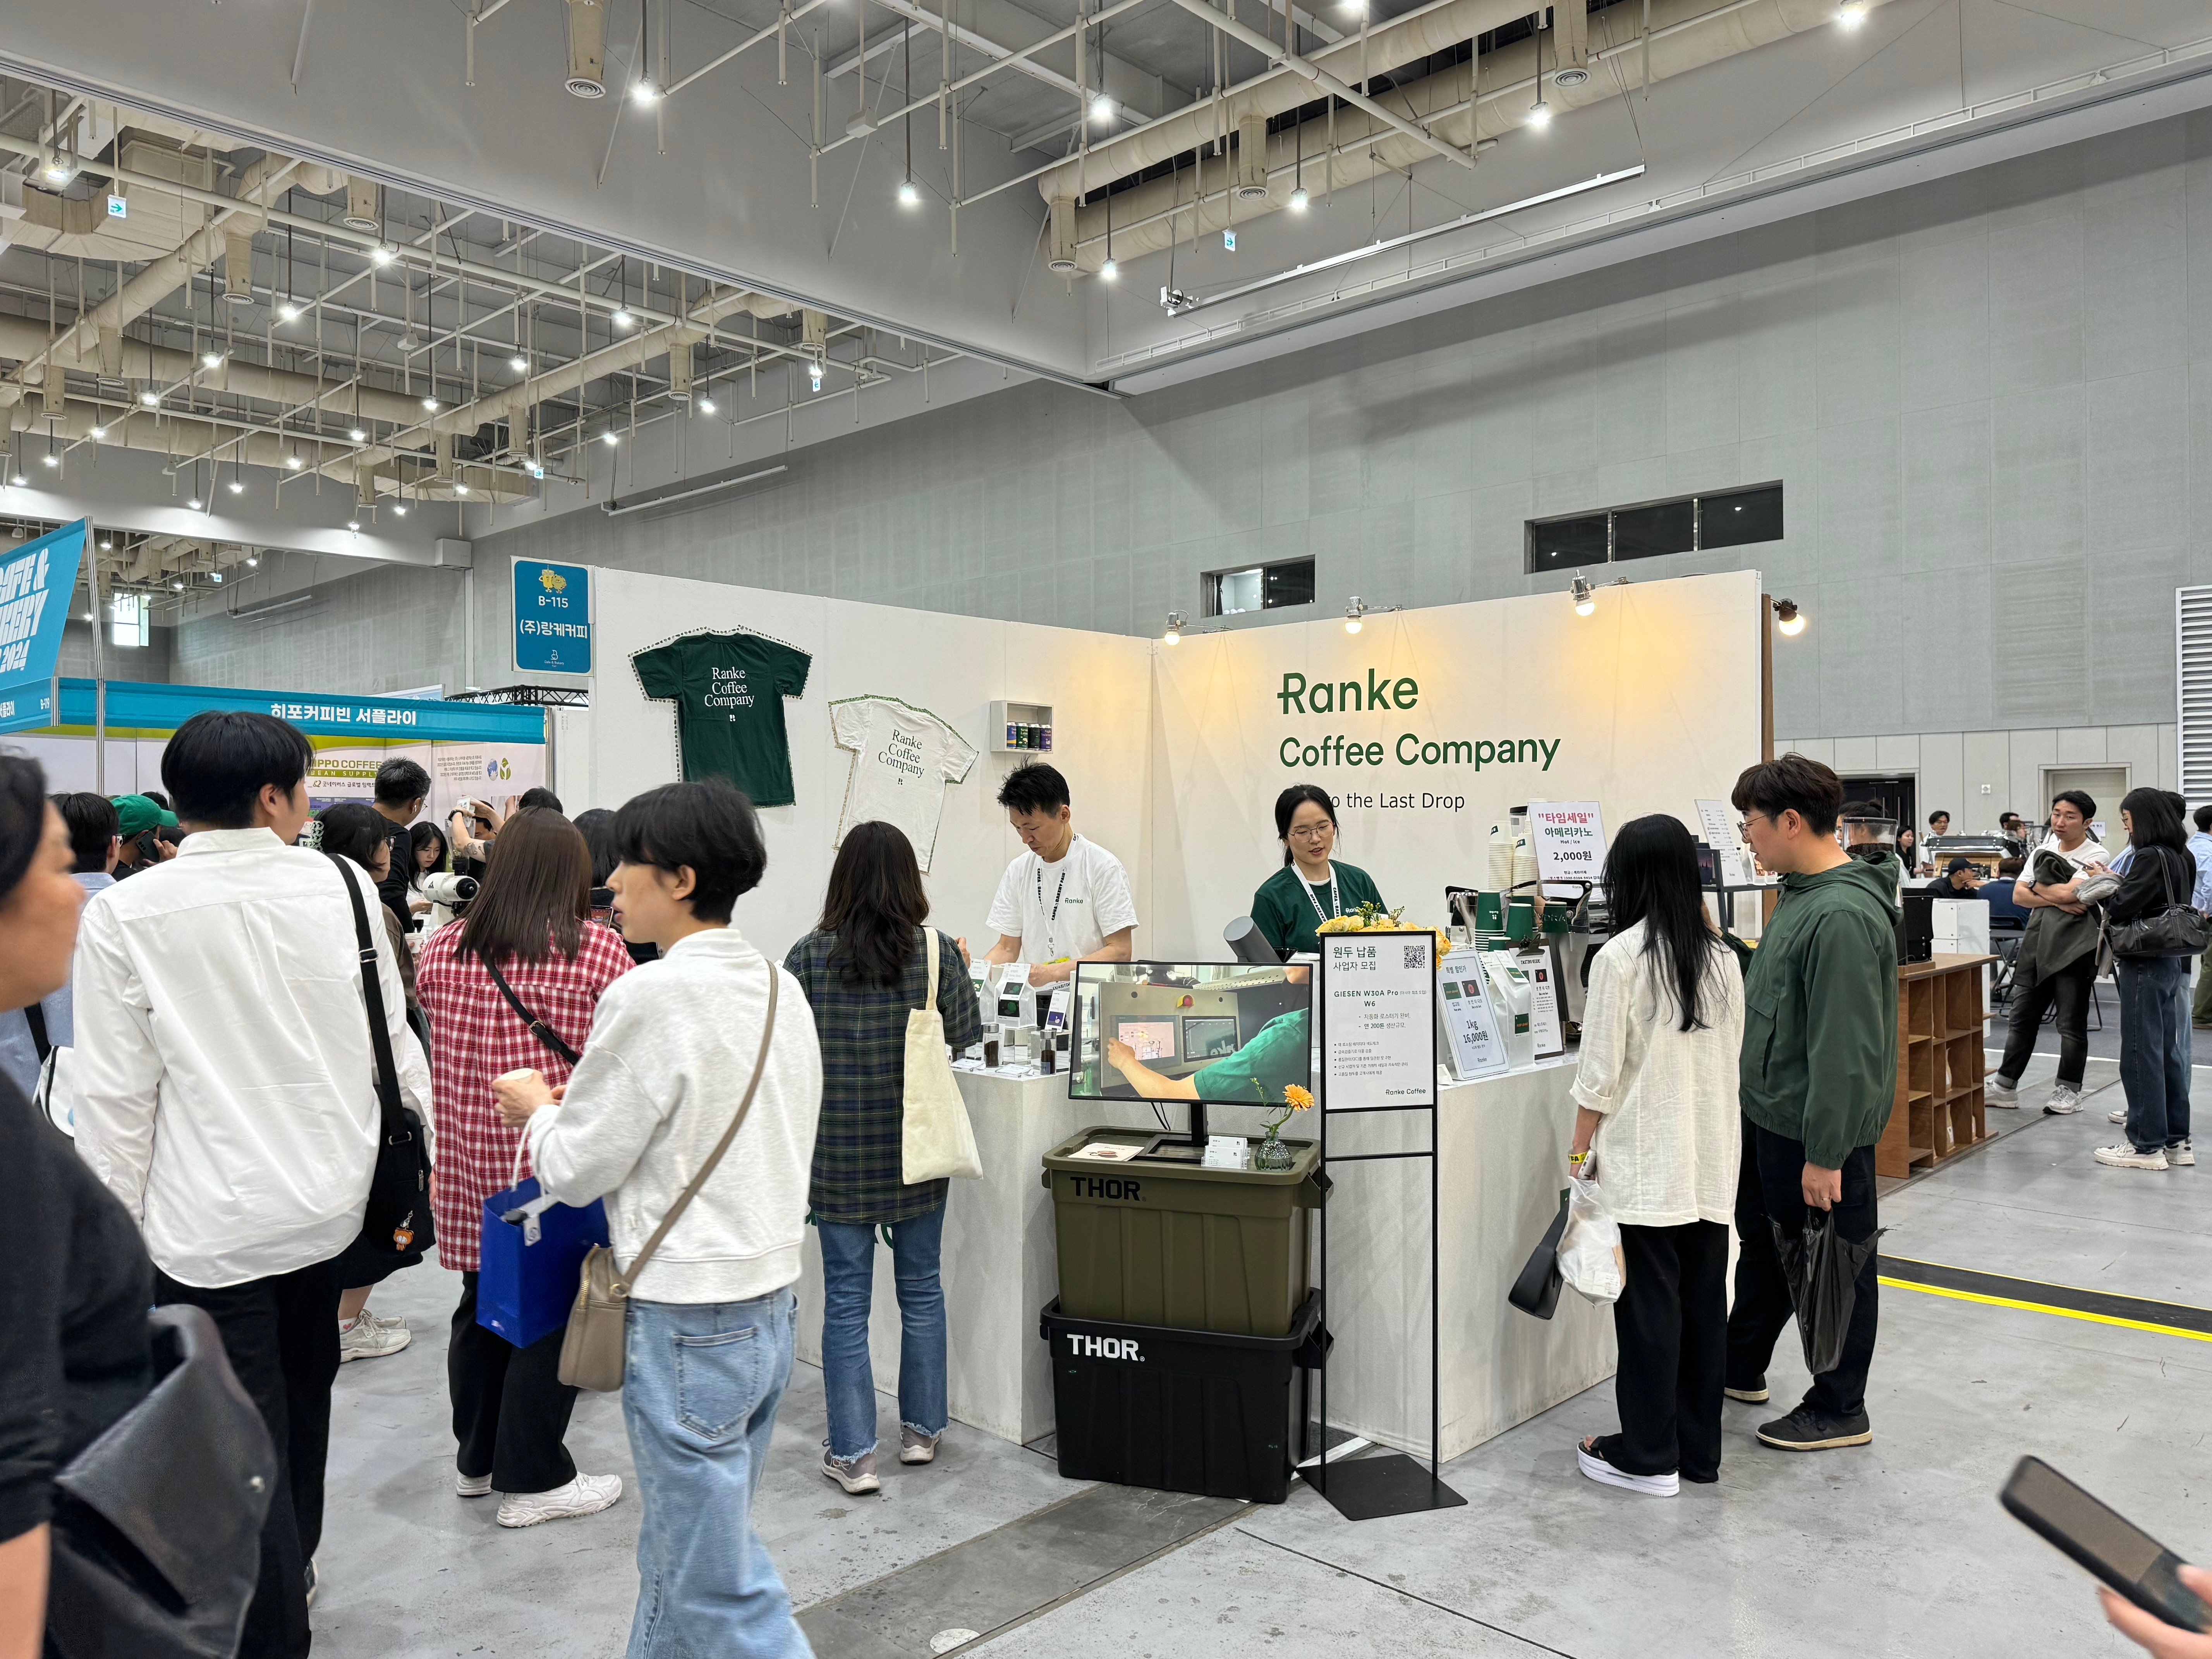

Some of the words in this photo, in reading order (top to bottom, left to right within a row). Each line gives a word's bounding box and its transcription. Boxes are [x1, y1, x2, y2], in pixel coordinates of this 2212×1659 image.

[539, 596, 568, 608] B-115
[520, 619, 587, 639] (주)랑케커피
[711, 666, 746, 680] Ranke
[712, 681, 747, 695] Coffee
[1277, 668, 1419, 714] Ranke
[704, 694, 755, 709] Company
[271, 703, 350, 723] 히포커피빈
[356, 708, 416, 725] 서플라이
[891, 729, 922, 750] Ranke
[889, 743, 921, 763] Coffee
[1279, 735, 1384, 767] Coffee
[1396, 733, 1561, 772] Company
[313, 759, 339, 768] IPPO
[878, 751, 925, 778] Company
[1346, 793, 1373, 808] the
[1380, 792, 1415, 809] Last
[1422, 792, 1465, 812] Drop
[1538, 812, 1594, 824] "타임세일"
[1545, 827, 1593, 837] 아메리카노
[1553, 851, 1592, 862] 2,000원
[1333, 946, 1353, 958] 원두
[1357, 946, 1377, 958] 납품
[1333, 962, 1358, 971] 사업자
[1360, 961, 1376, 971] 모집
[1466, 1019, 1478, 1030] 1kg
[1463, 1030, 1489, 1044] 16,000원
[1070, 1176, 1140, 1201] THOR
[1067, 1334, 1139, 1361] THOR
